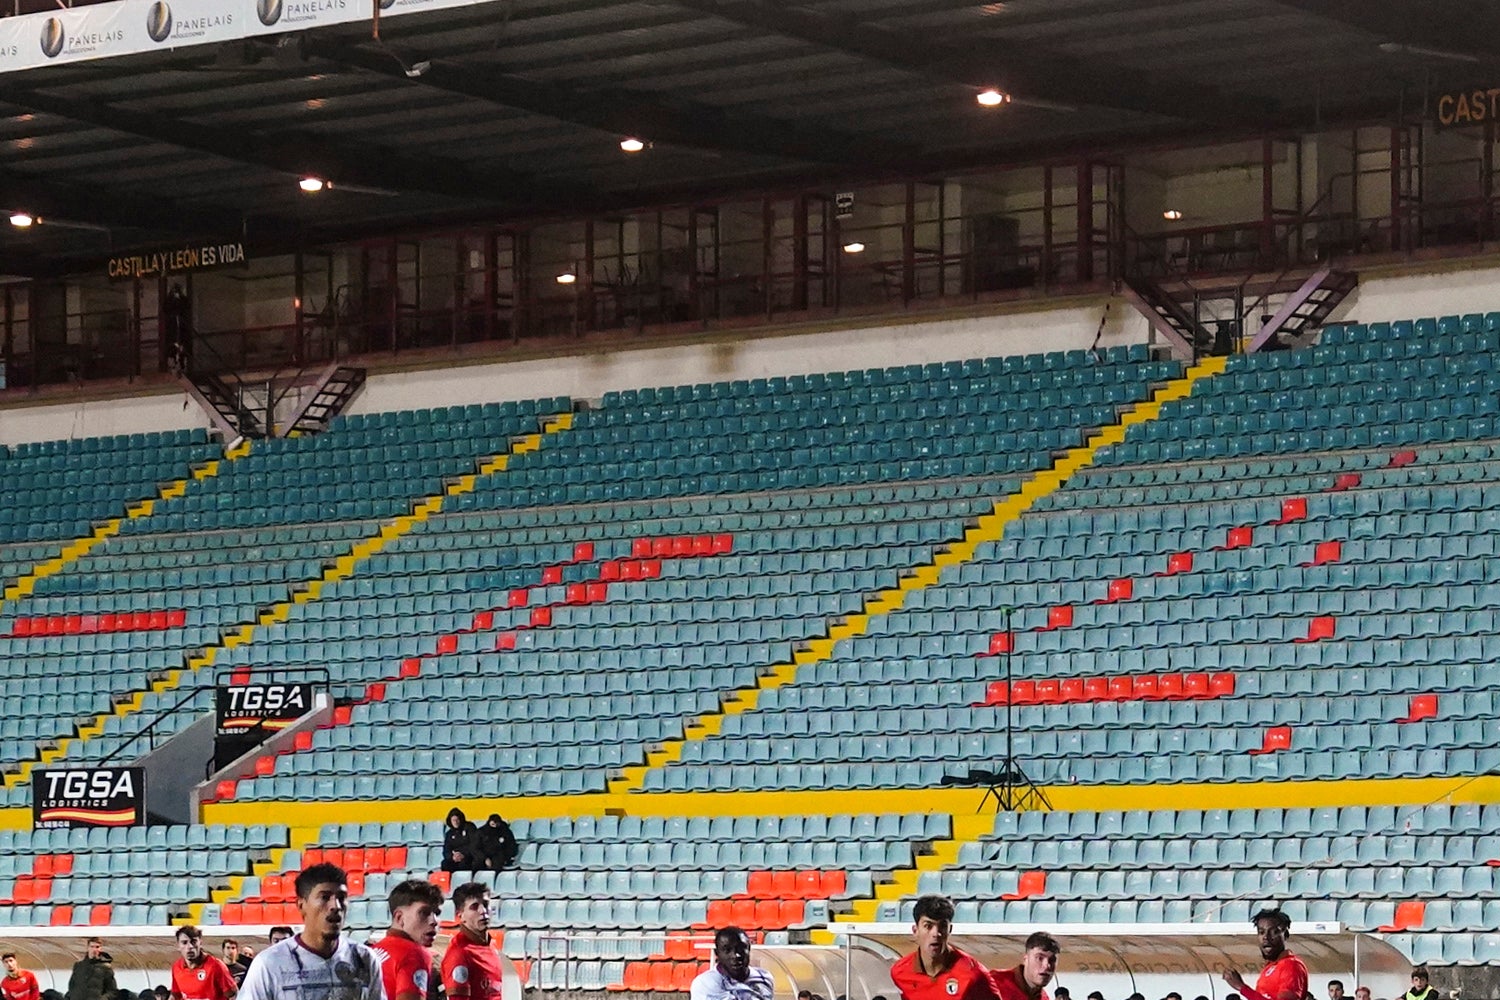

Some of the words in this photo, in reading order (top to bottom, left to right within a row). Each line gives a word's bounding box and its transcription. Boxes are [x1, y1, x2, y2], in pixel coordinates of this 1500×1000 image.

[287, 0, 346, 15] PANELAIS
[175, 14, 233, 31] PANELAIS
[68, 30, 124, 46] PANELAIS
[108, 254, 160, 277] CASTILLA
[160, 252, 168, 271] Y
[170, 245, 199, 270] LEÓN
[201, 246, 216, 265] ES
[218, 243, 245, 263] VIDA
[227, 686, 304, 710] TGSA
[45, 771, 135, 799] TGSA
